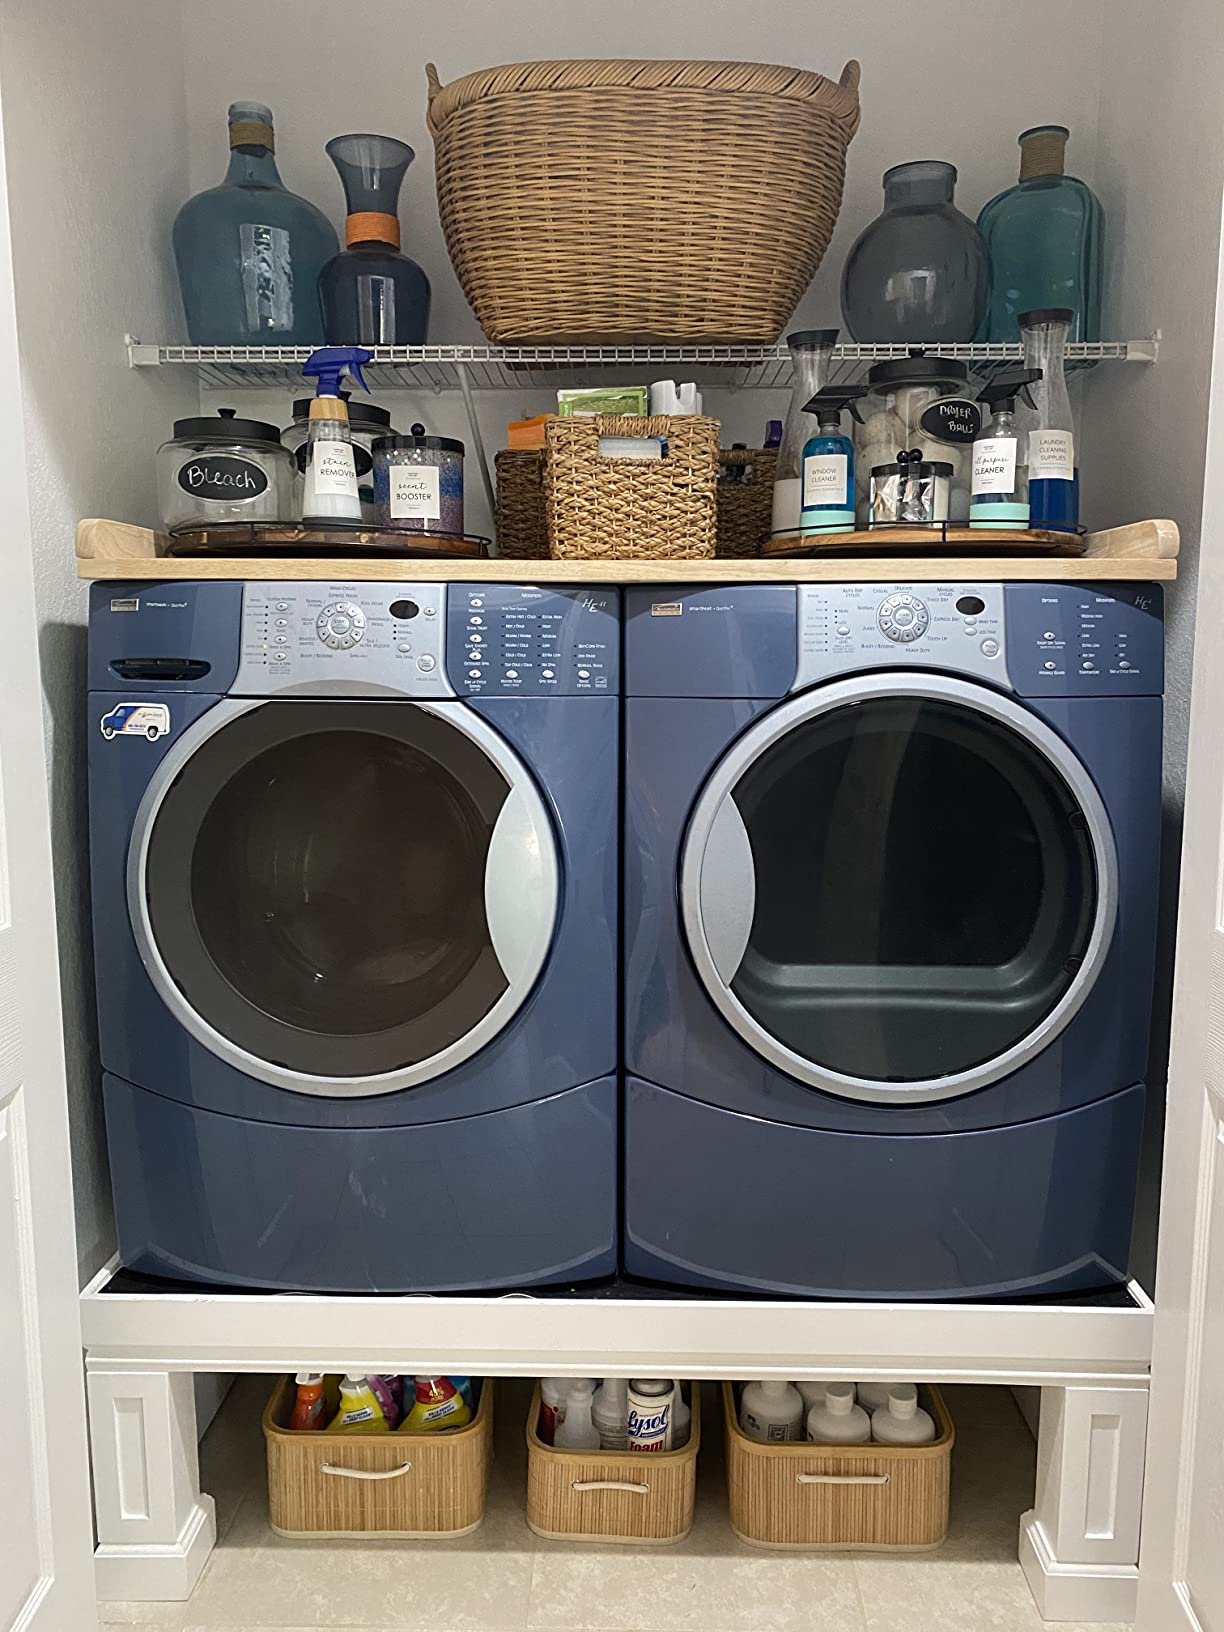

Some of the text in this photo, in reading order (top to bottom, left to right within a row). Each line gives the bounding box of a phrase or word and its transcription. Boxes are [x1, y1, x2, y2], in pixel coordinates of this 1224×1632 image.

[940, 405, 973, 419] DRYER
[320, 468, 354, 478] REMOVER
[975, 466, 1004, 475] CLEANER
[187, 465, 256, 489] Bleach
[398, 482, 428, 490] scent
[396, 493, 432, 501] BOOSTER
[628, 1404, 670, 1437] Lysol
